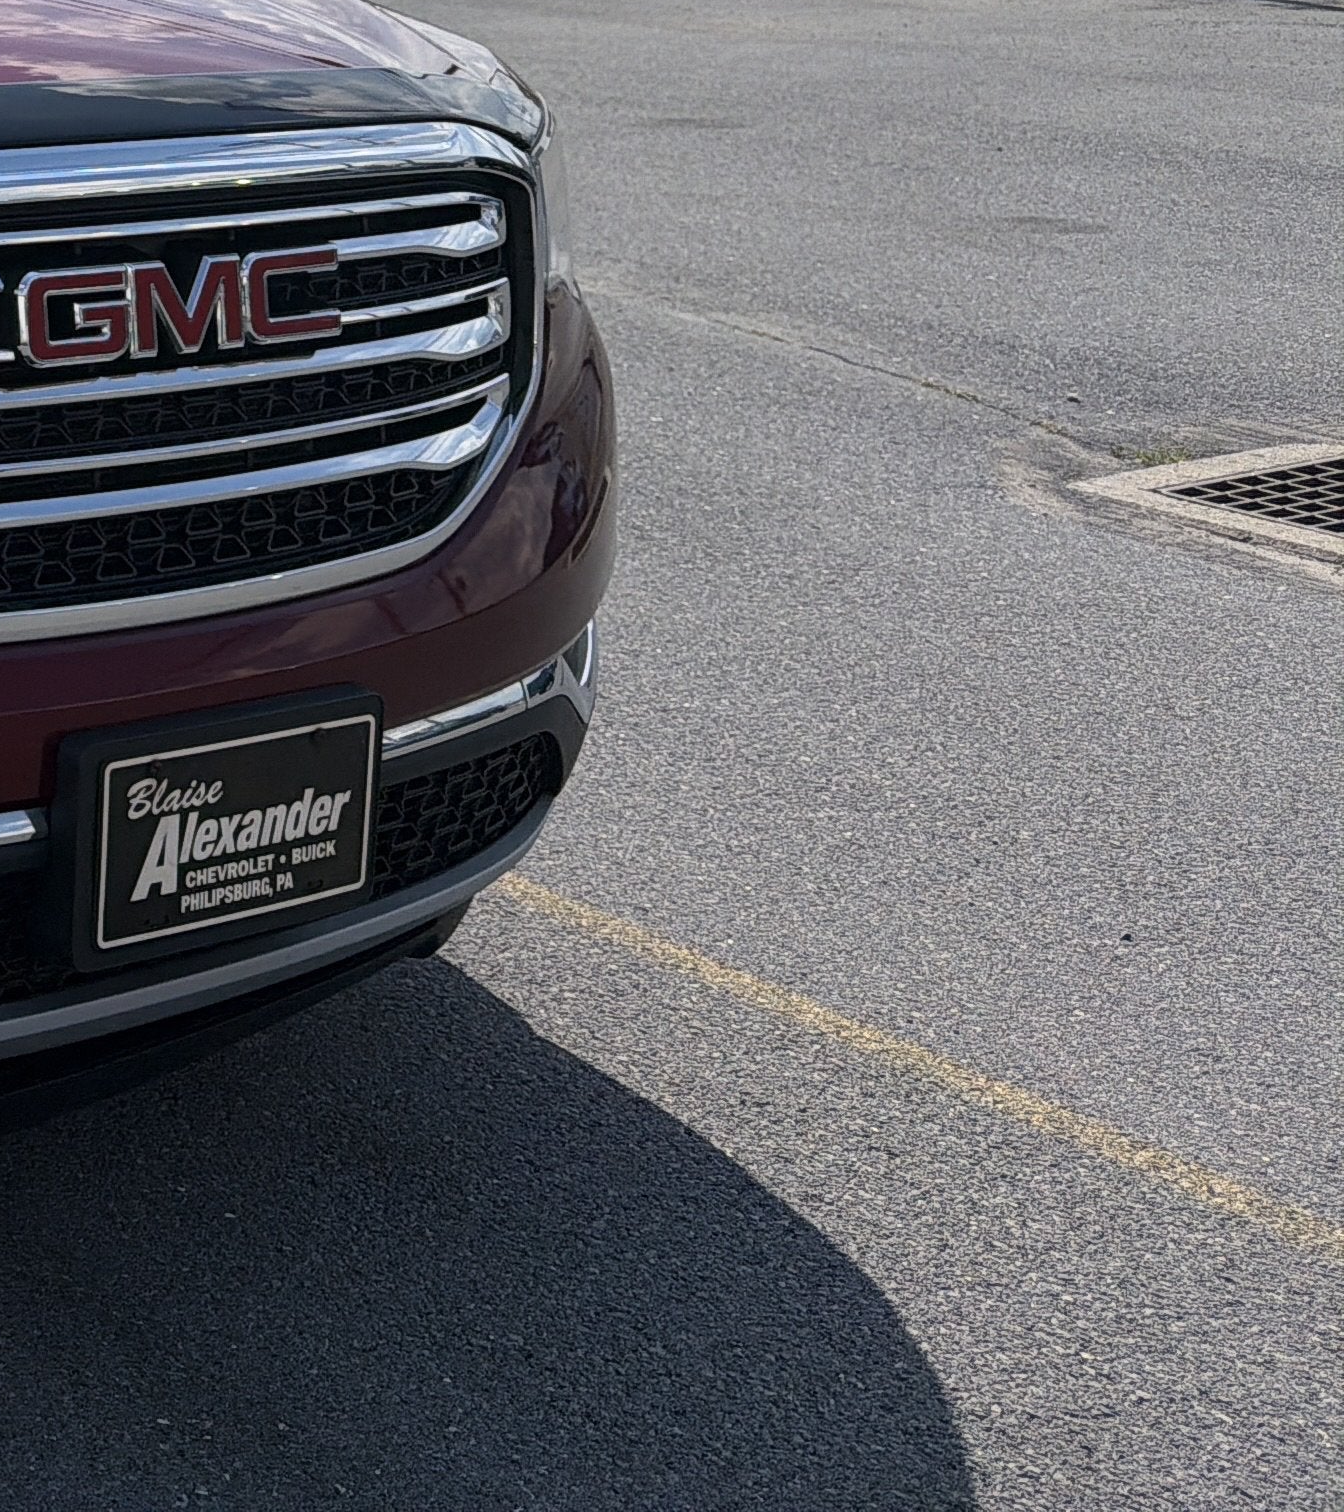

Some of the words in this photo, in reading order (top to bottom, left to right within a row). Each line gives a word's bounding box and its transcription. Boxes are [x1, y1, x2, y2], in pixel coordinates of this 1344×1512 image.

[15, 243, 342, 368] GMC
[127, 778, 224, 820] Blaise
[130, 788, 352, 902] Alexander
[185, 854, 276, 889] CHEVROLET
[291, 839, 337, 866] BUICK
[180, 878, 274, 914] PHILIPSBURG,
[275, 871, 294, 892] PA
